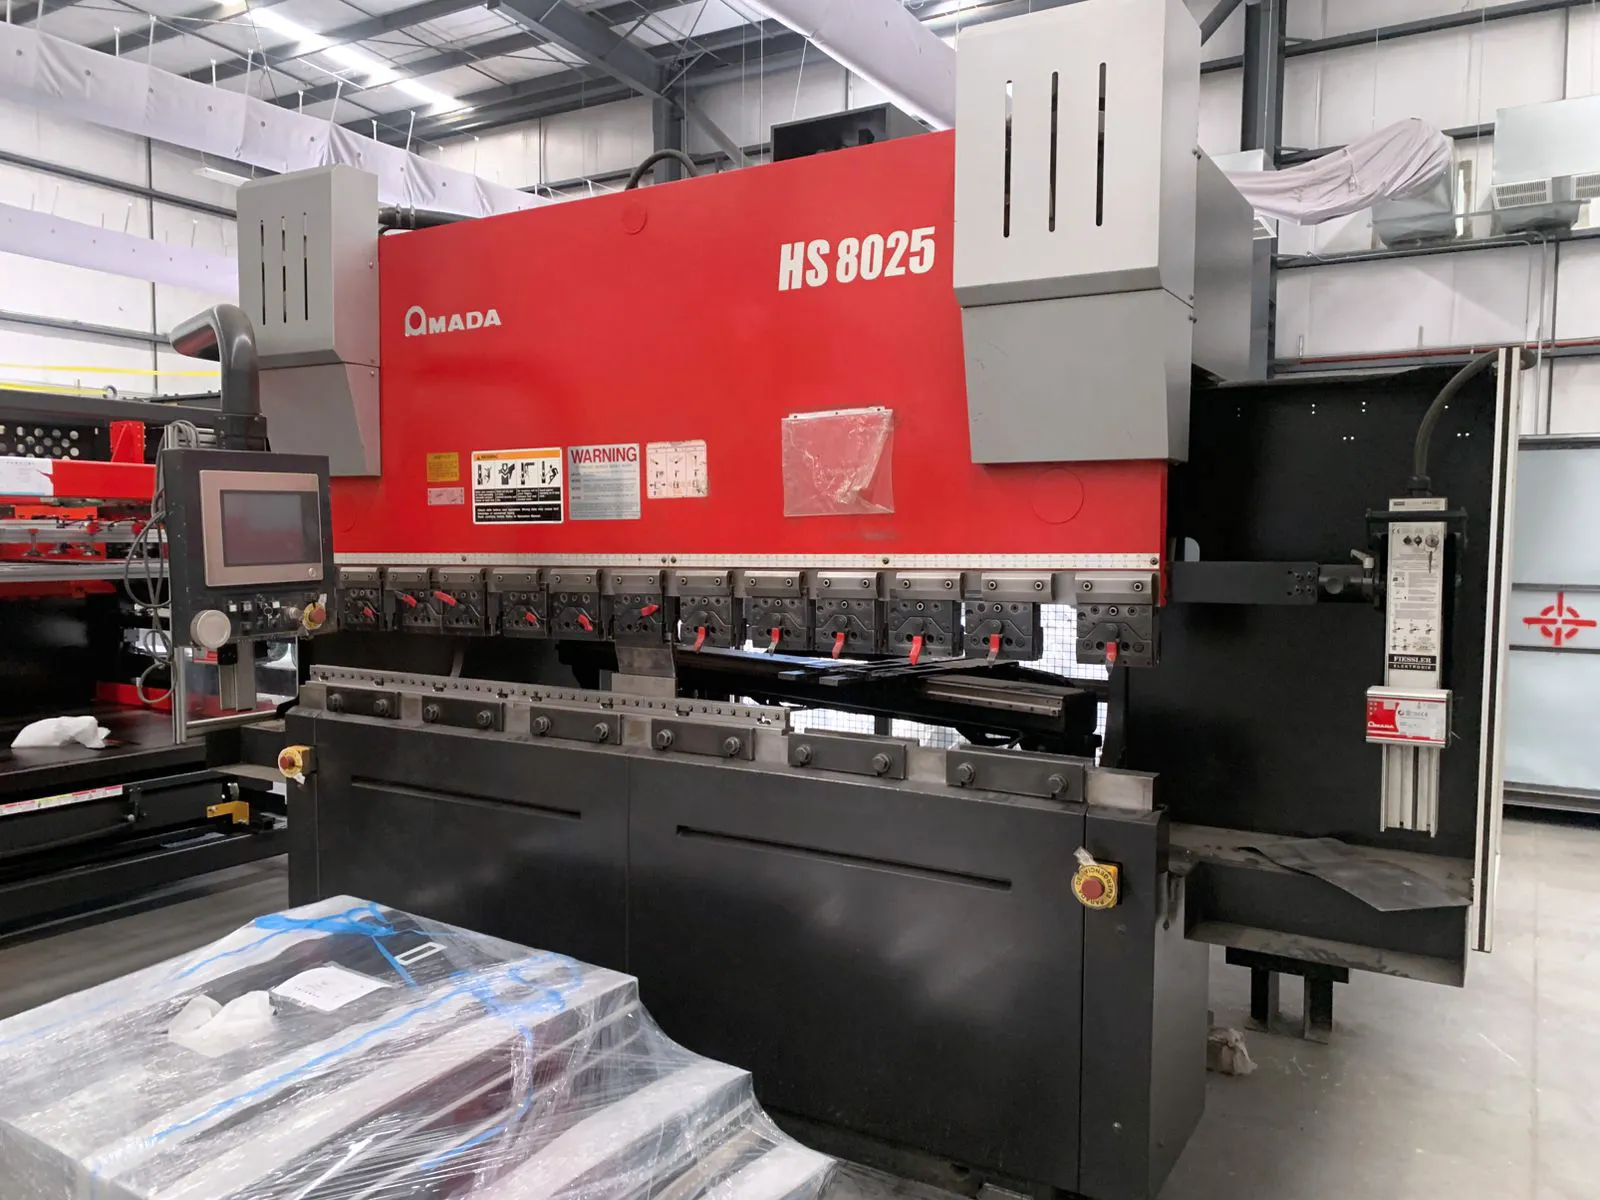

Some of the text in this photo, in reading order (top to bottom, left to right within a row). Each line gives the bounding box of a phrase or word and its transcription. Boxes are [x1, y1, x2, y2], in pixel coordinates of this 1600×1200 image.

[778, 226, 935, 291] HS 8025
[405, 305, 502, 337] AMADA
[571, 447, 637, 464] WARNING
[1394, 656, 1432, 664] FIESSLER
